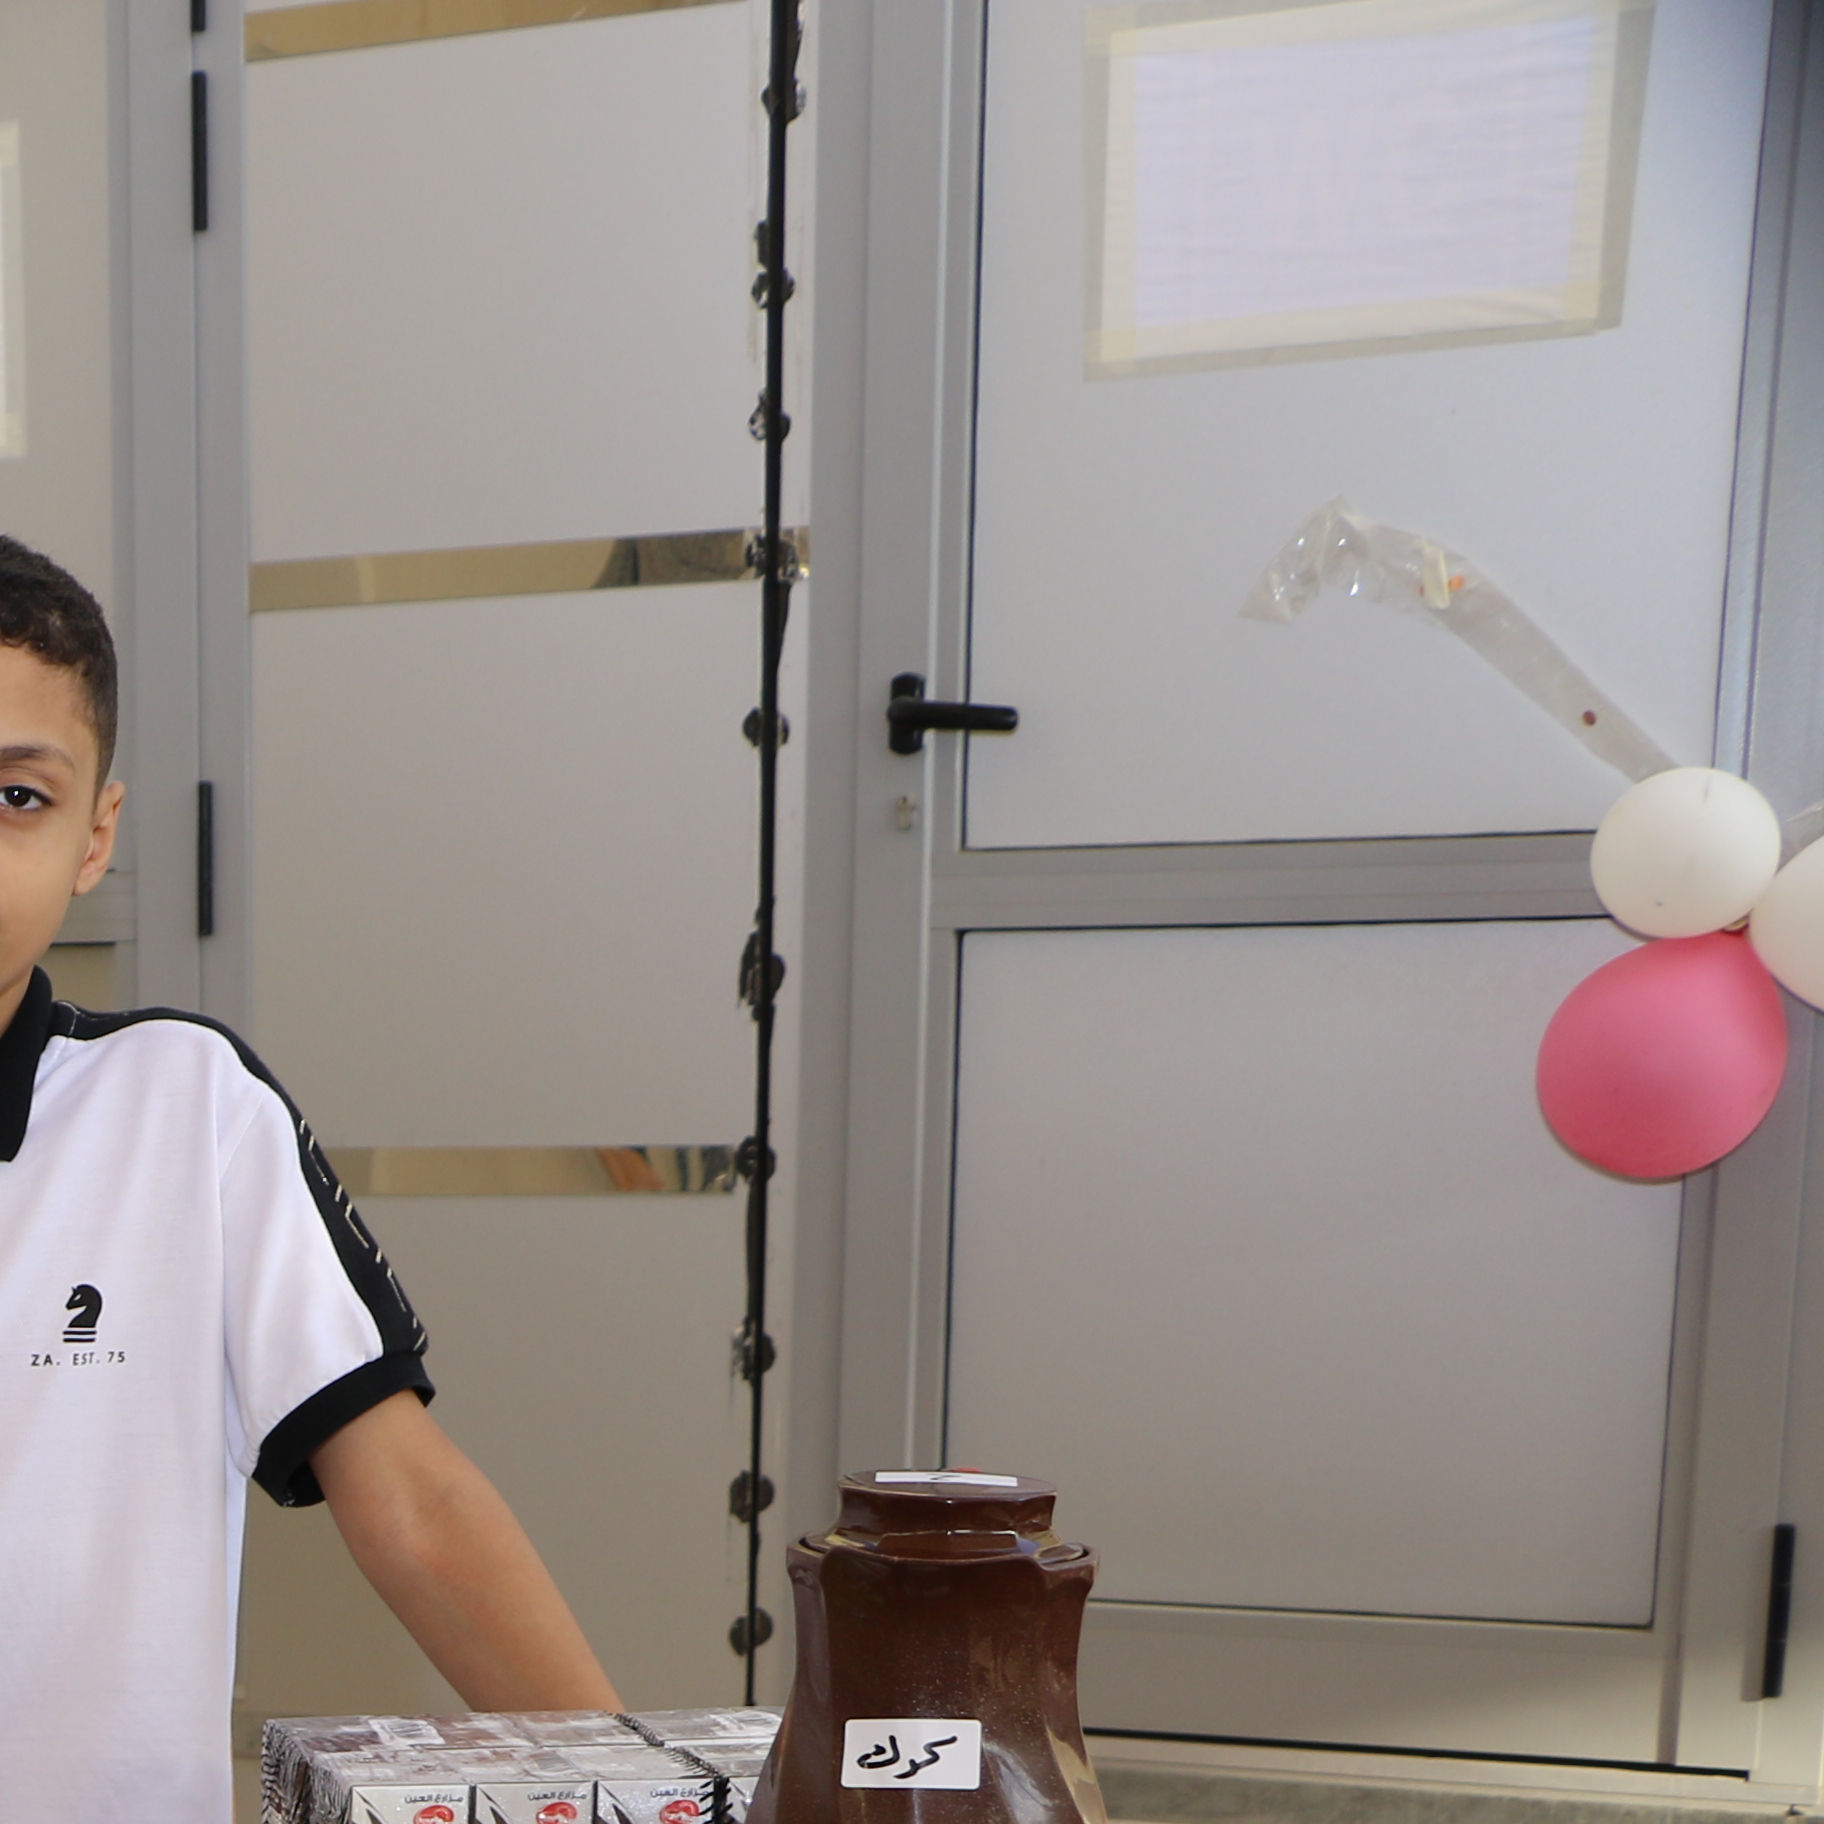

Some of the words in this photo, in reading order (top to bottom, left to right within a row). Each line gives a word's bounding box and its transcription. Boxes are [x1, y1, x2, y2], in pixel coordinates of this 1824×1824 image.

[31, 1353, 60, 1366] ZA.
[73, 1351, 100, 1366] EST.
[107, 1350, 126, 1364] 75
